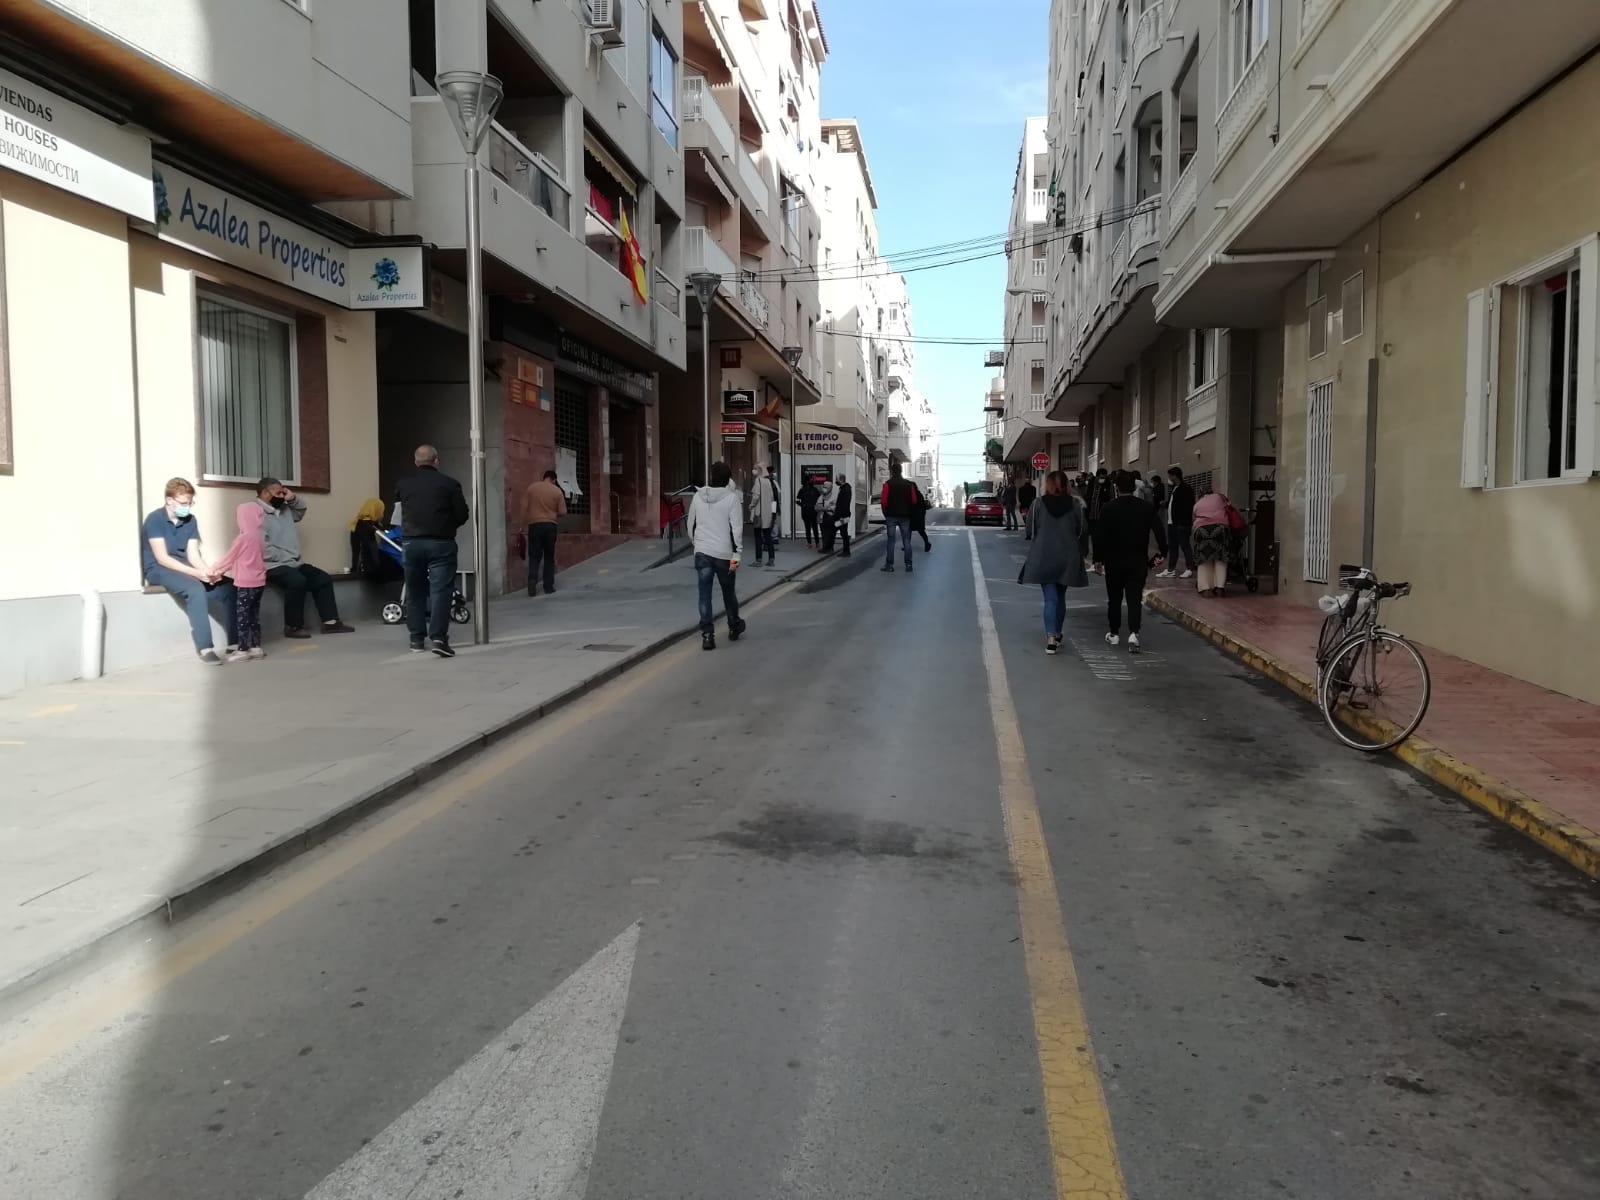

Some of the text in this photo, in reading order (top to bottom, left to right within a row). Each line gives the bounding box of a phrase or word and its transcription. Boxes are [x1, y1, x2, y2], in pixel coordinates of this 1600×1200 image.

[4, 116, 58, 151] HOUSES
[180, 187, 346, 288] Azalea Properties
[357, 291, 417, 304] Azalea Properties
[804, 433, 839, 441] TEMPLO
[807, 443, 843, 451] PINCHO
